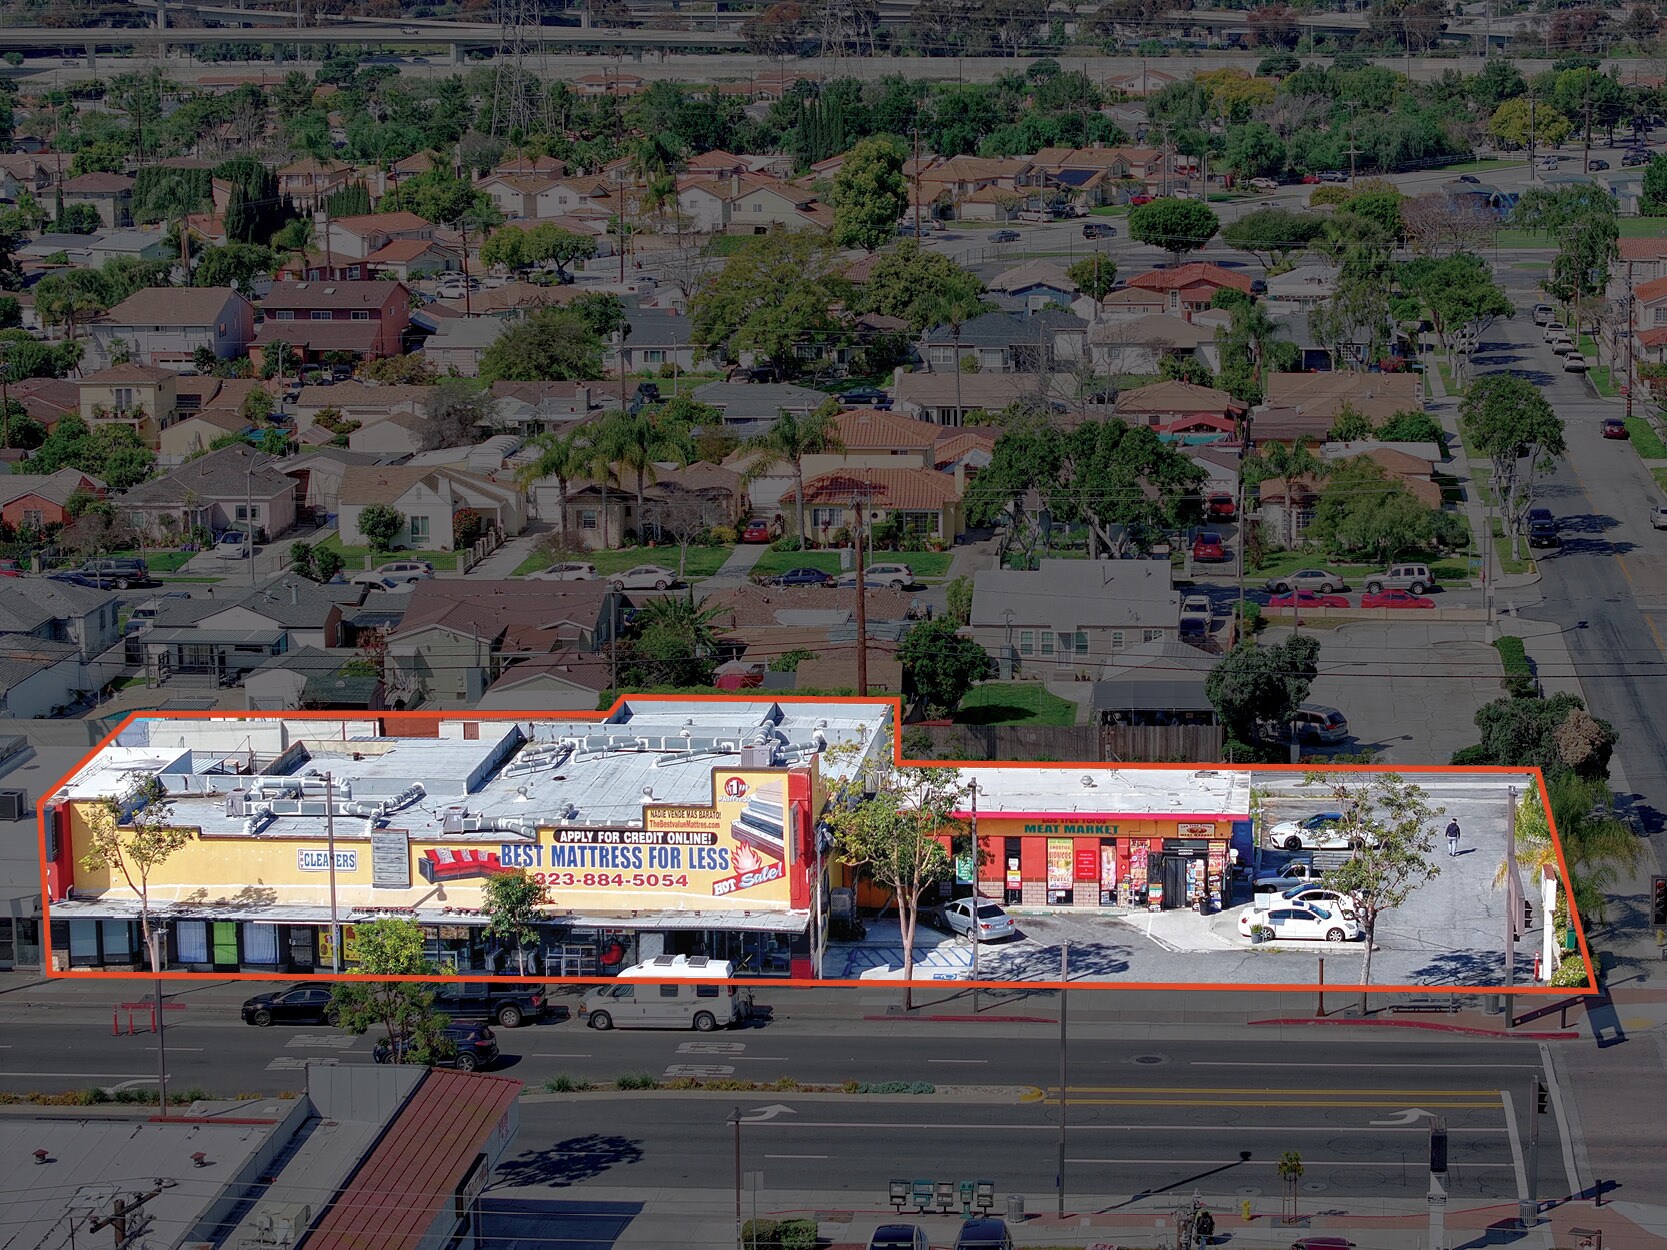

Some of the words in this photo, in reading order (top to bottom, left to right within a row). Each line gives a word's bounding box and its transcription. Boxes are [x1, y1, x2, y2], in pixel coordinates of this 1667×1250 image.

[650, 810, 667, 818] NADIE
[667, 810, 685, 818] VENDE
[686, 811, 697, 819] MAS
[699, 811, 721, 819] BARATO!
[1025, 825, 1060, 833] MEAT
[1064, 825, 1119, 834] MARKET
[559, 831, 594, 844] APPLY
[598, 831, 619, 844] FOR
[624, 831, 666, 844] CREDIT
[669, 832, 712, 844] ONLINE!
[304, 853, 355, 867] CLEAERS
[501, 844, 544, 868] BEST
[551, 844, 643, 870] MATTRESS
[648, 845, 681, 870] FOR
[687, 846, 730, 871] LESS
[535, 872, 688, 888] 323-884-5054
[713, 878, 737, 896] HOT
[739, 862, 783, 888] Sale!
